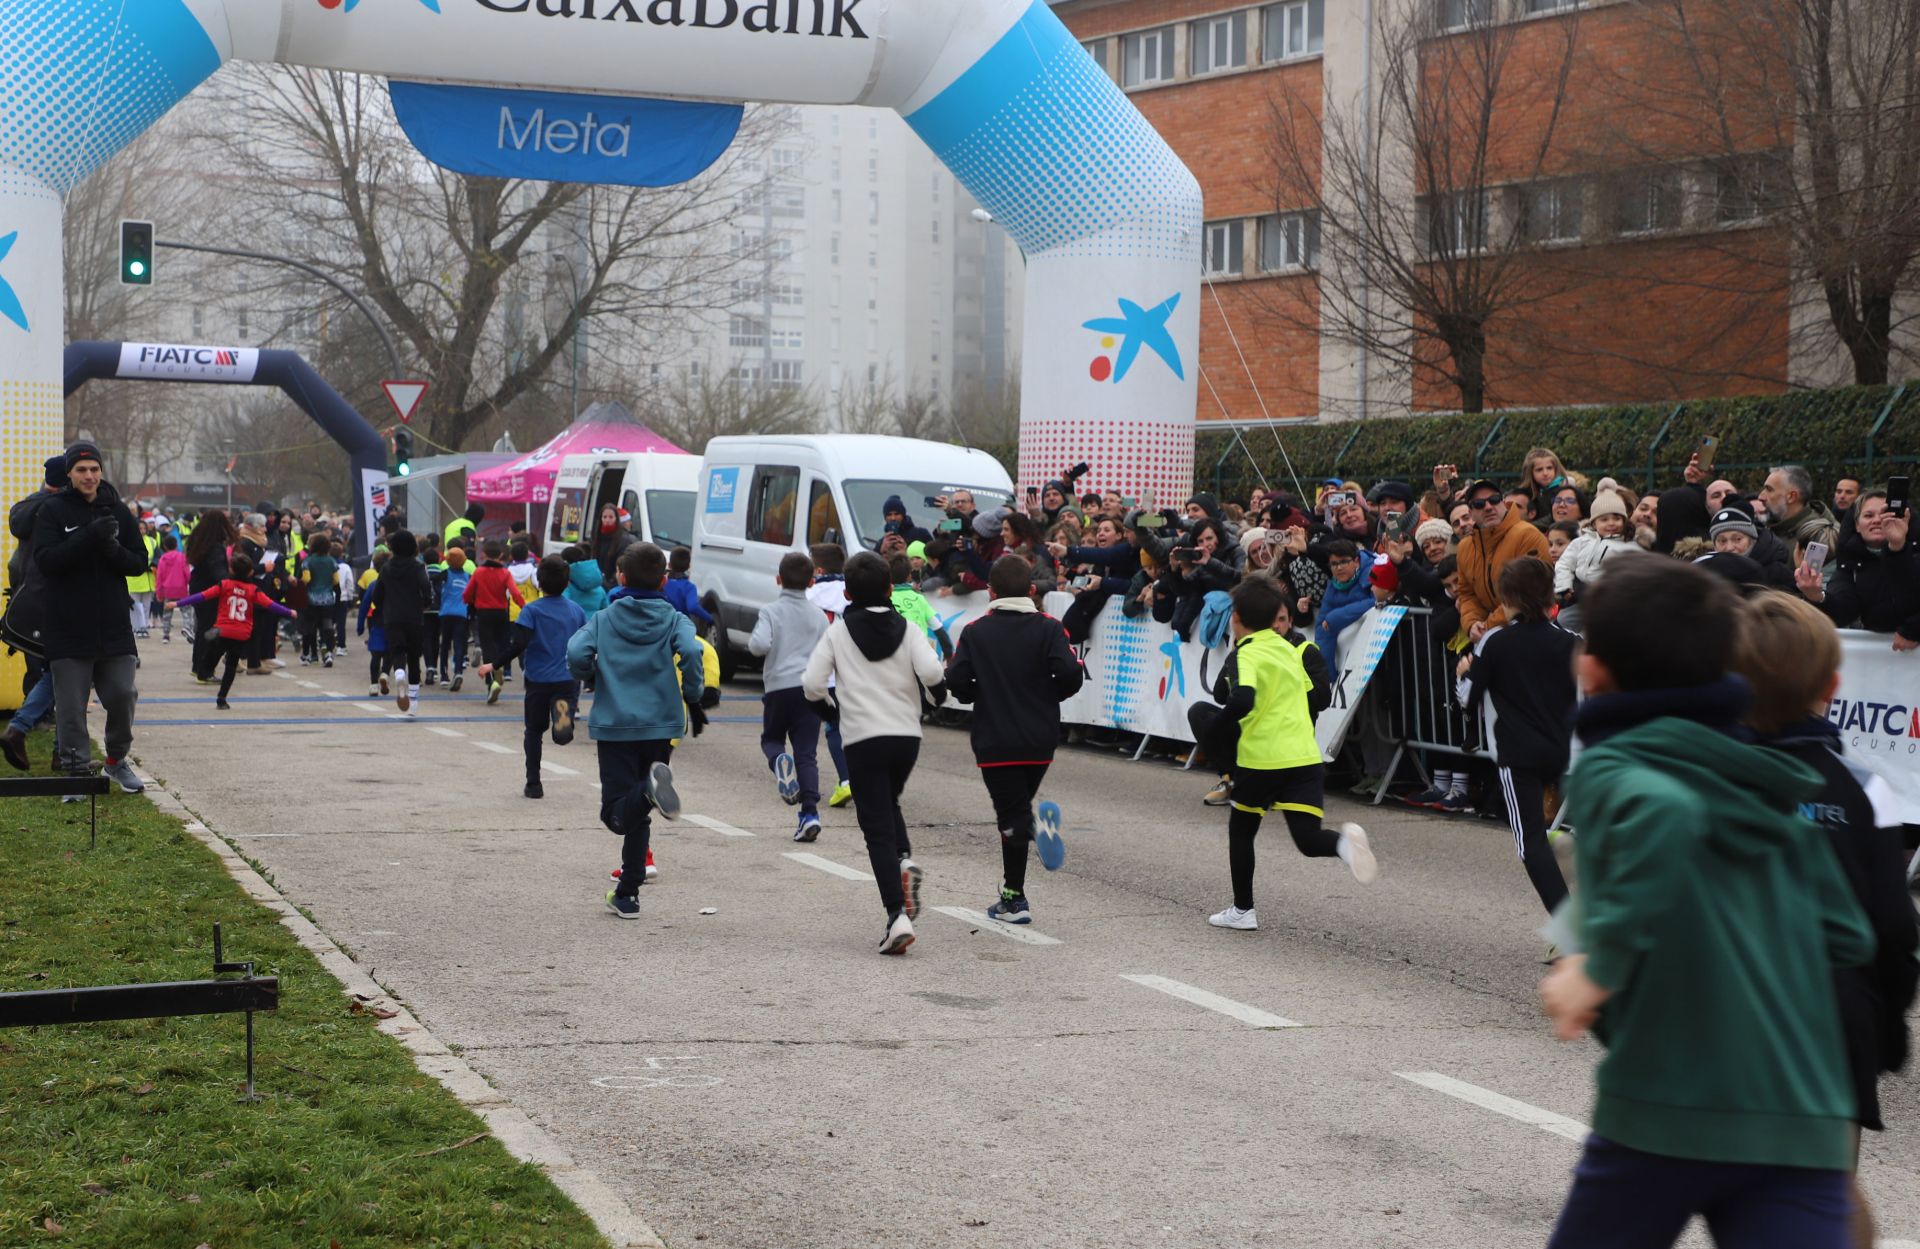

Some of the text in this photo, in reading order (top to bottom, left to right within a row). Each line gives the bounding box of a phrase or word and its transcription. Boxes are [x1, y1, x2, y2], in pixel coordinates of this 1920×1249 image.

[498, 106, 631, 157] Meta
[140, 347, 213, 365] FIATC
[138, 365, 238, 375] SEGUROS
[227, 595, 248, 621] 13
[1824, 699, 1908, 736] FIATC
